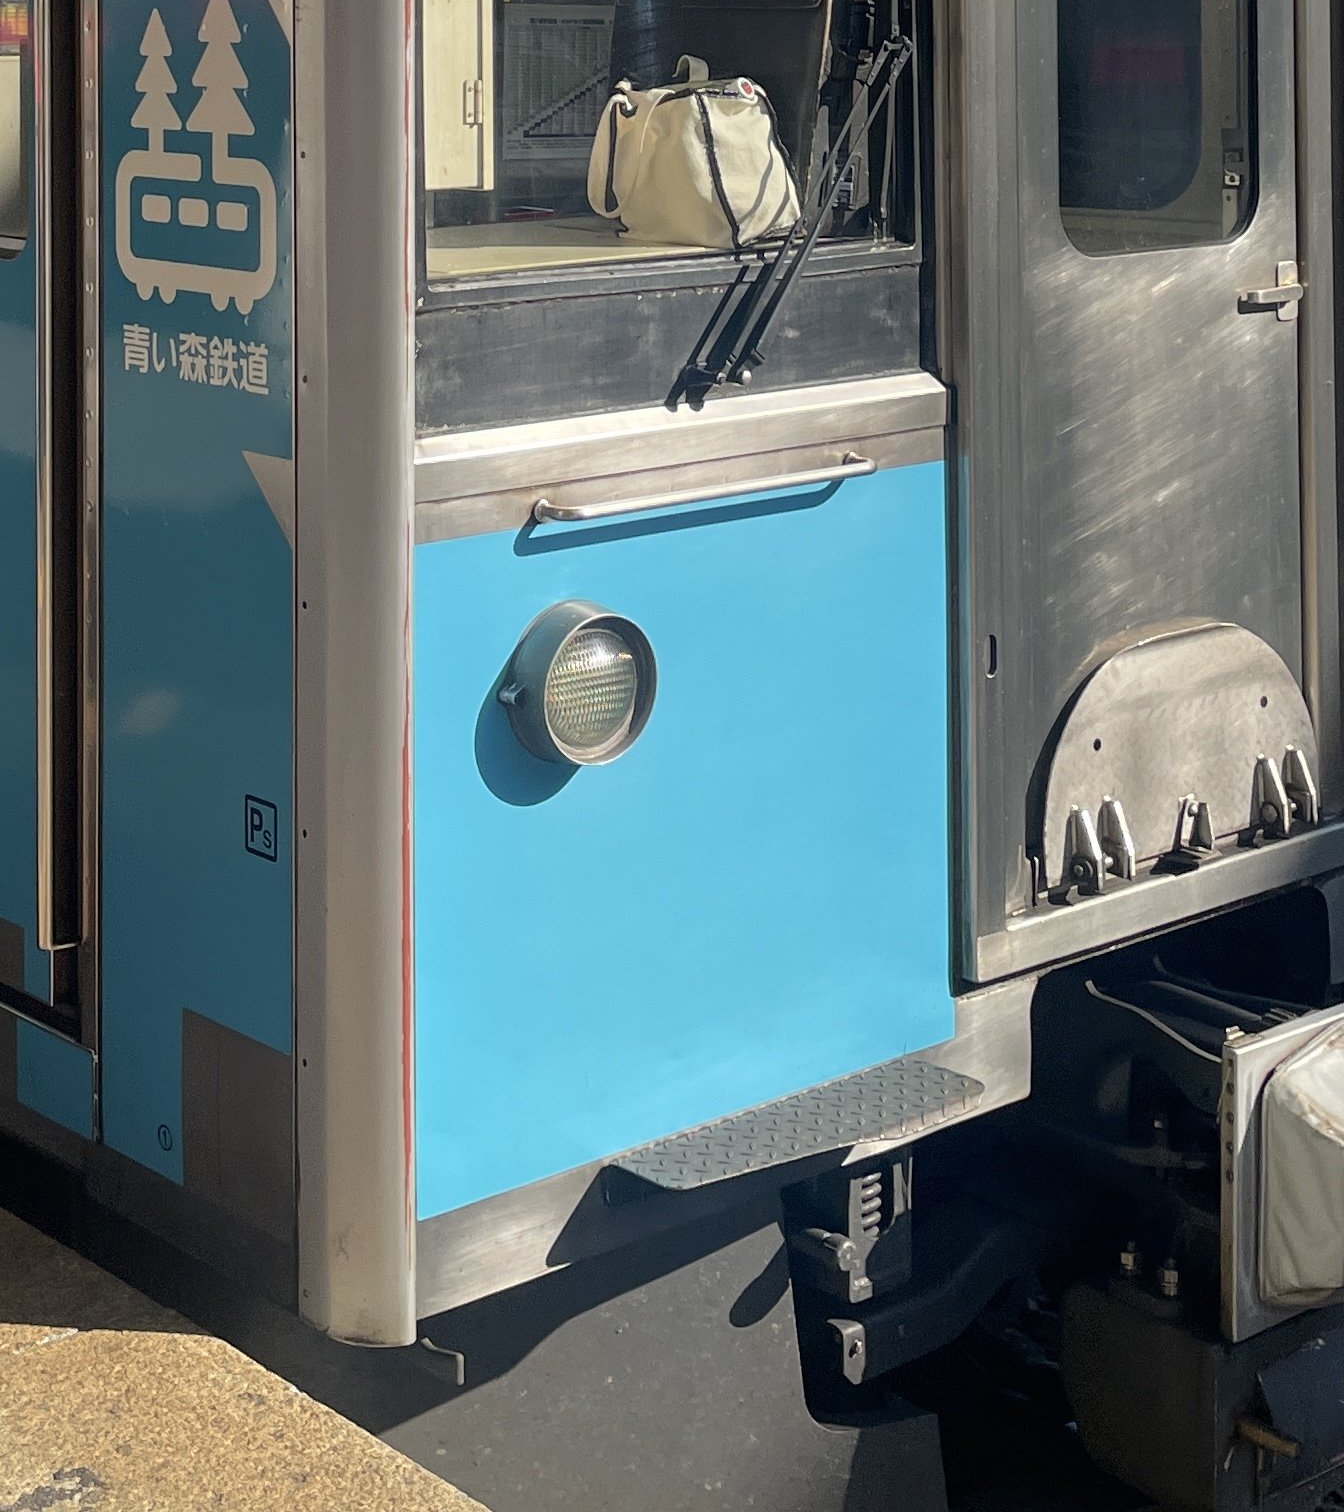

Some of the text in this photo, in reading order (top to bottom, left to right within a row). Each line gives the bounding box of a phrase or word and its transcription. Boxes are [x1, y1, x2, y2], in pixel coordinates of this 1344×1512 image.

[122, 323, 270, 396] 青い森鉄道
